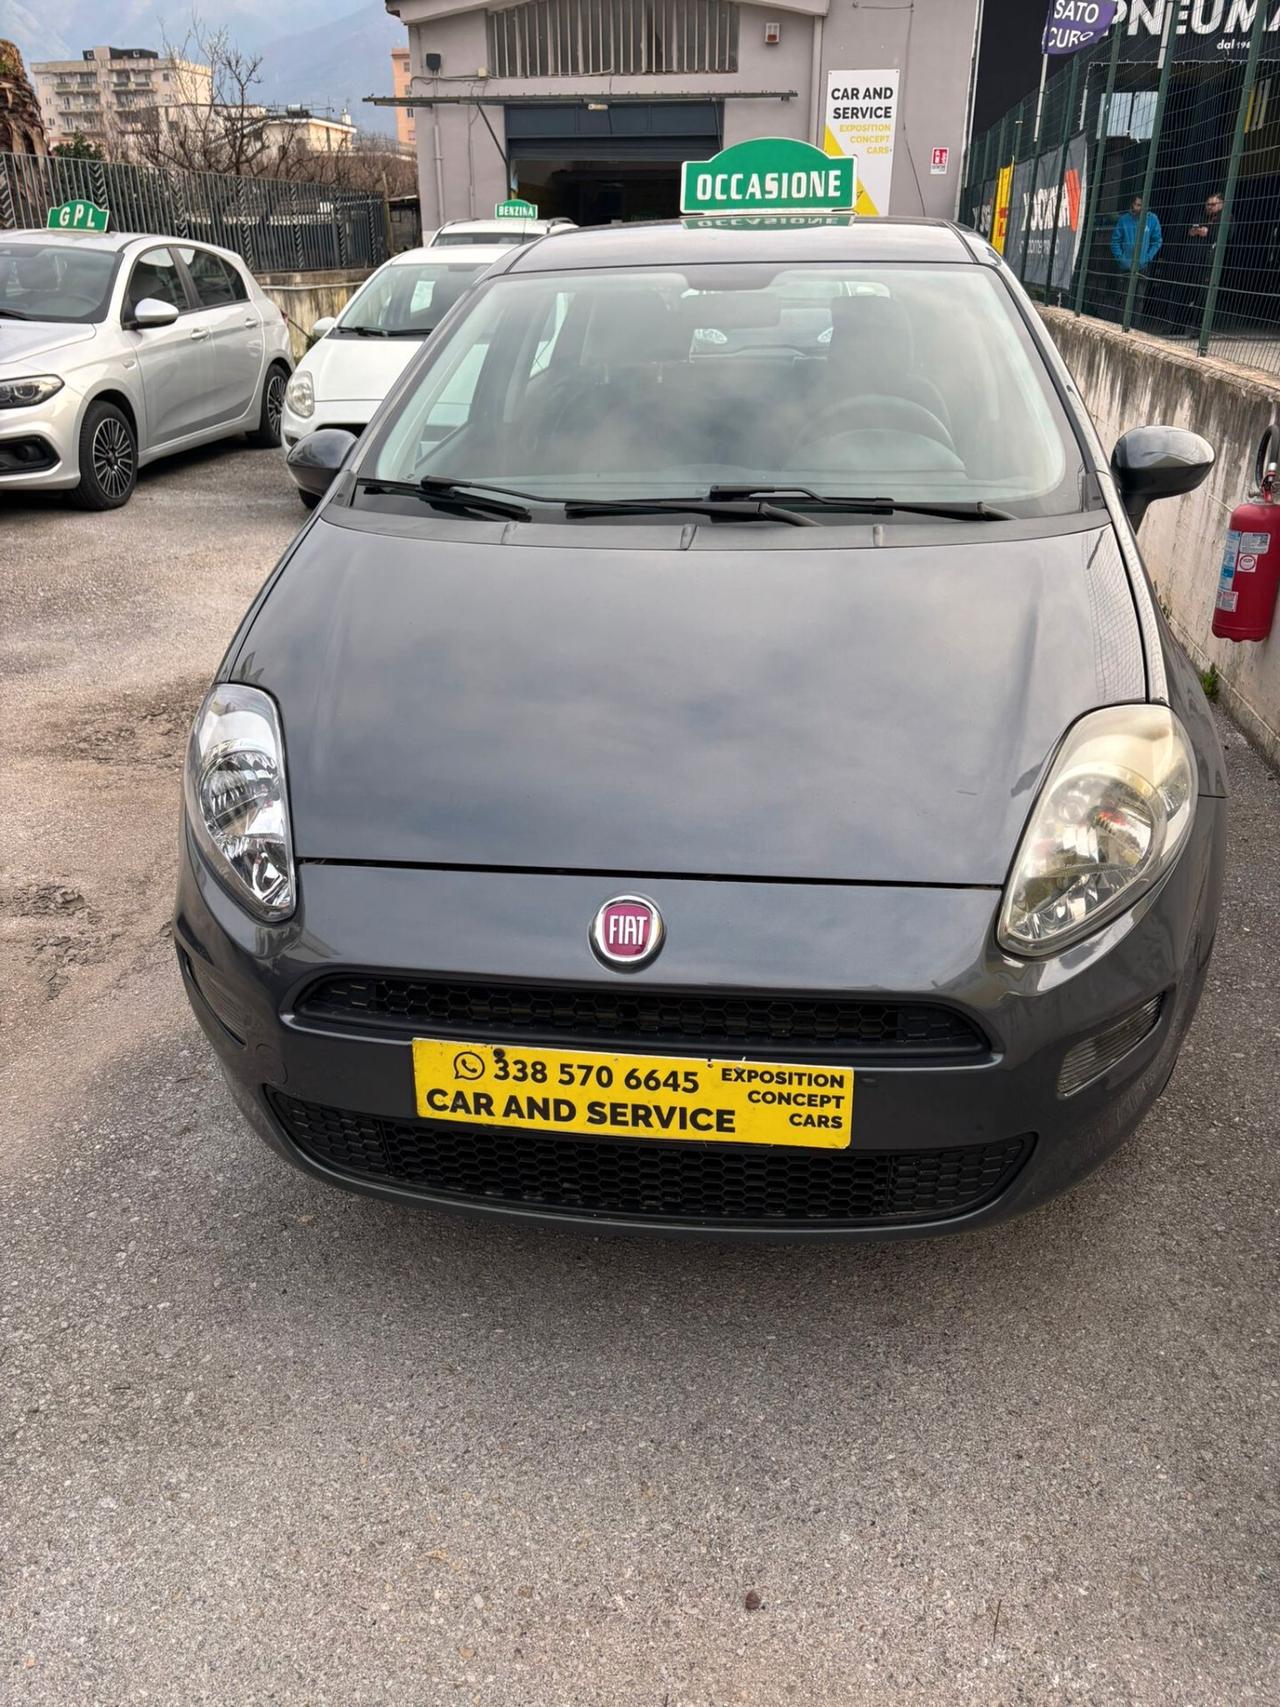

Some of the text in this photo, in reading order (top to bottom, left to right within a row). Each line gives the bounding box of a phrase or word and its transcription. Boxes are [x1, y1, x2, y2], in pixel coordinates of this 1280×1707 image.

[1054, 0, 1099, 23] SATO
[1216, 38, 1236, 50] dal
[831, 87, 893, 100] CAR AND
[833, 106, 892, 119] SERVICE
[840, 123, 891, 132] EXPOSITION
[850, 135, 890, 144] CONCEPT
[866, 146, 889, 154] CARS
[696, 170, 841, 200] OCCASIONE
[59, 204, 96, 227] GPL
[498, 205, 534, 217] BENZINA
[609, 915, 648, 945] FIAT
[493, 1057, 700, 1094] 338 570 6645
[721, 1067, 844, 1089] EXPOSITION
[747, 1090, 845, 1109] CONCEPT
[426, 1088, 736, 1133] CAR AND SERVICE
[788, 1112, 843, 1129] CARS
